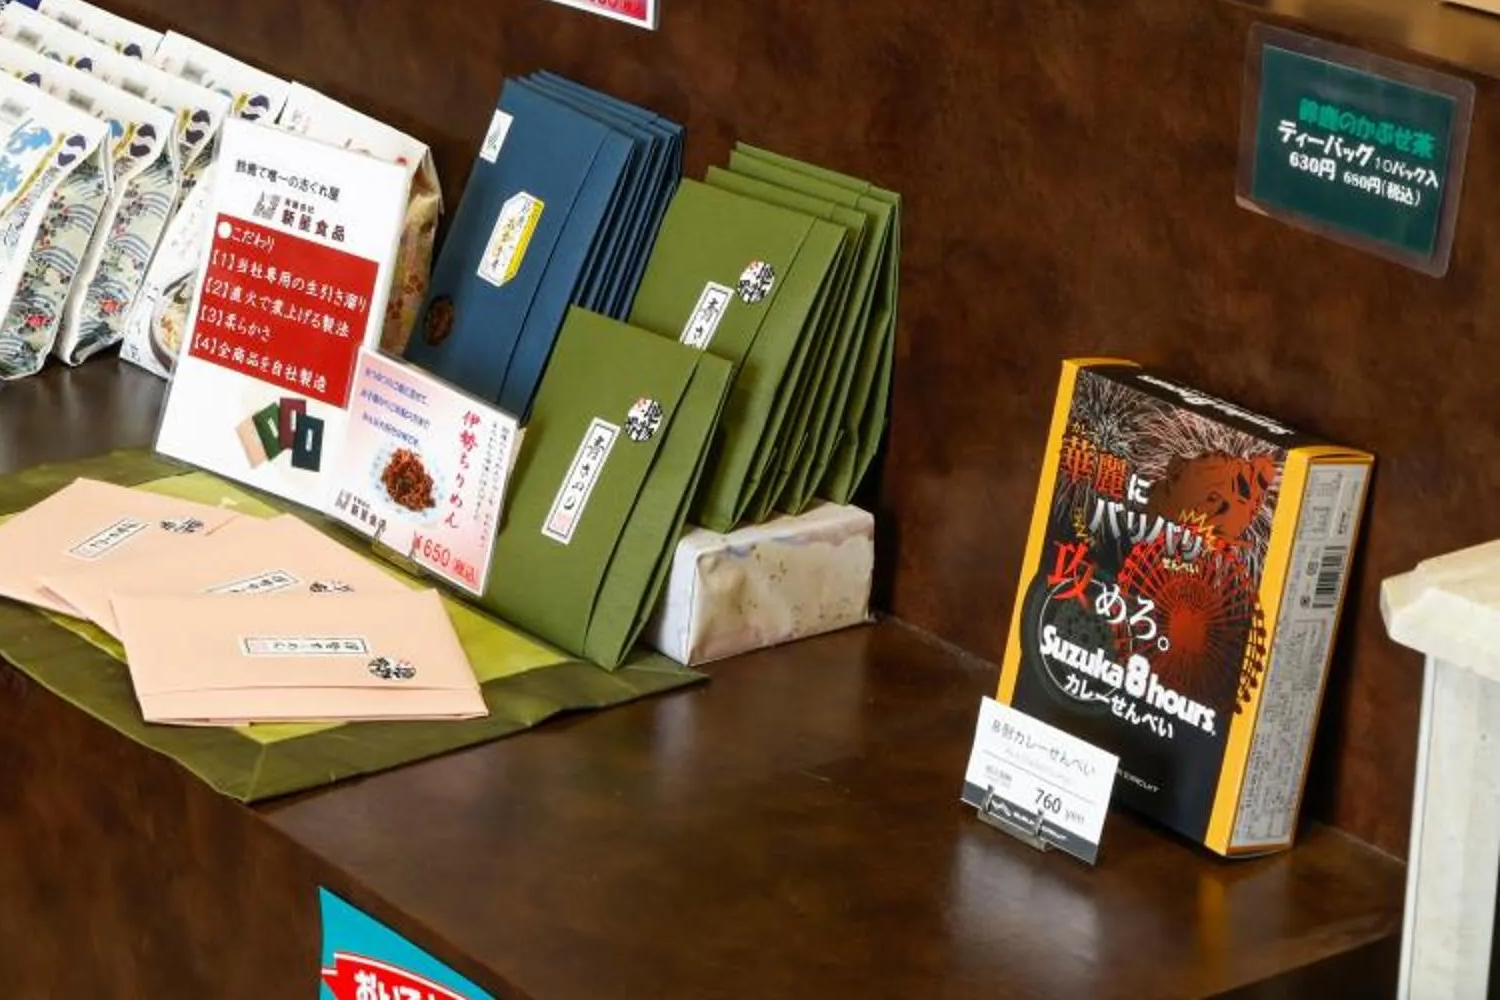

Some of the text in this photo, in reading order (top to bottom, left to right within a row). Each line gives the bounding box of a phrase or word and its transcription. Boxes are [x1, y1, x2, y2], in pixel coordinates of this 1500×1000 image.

[1277, 119, 1376, 168] ティーバッグ
[1288, 151, 1337, 182] 630円
[231, 226, 276, 253] こだわり
[1089, 498, 1203, 561] バリバリ
[1047, 540, 1171, 652] 攻めろ。
[1039, 624, 1216, 733] Suzuka 8 hours
[1064, 672, 1175, 740] カレーせんべい
[1035, 787, 1063, 815] 760
